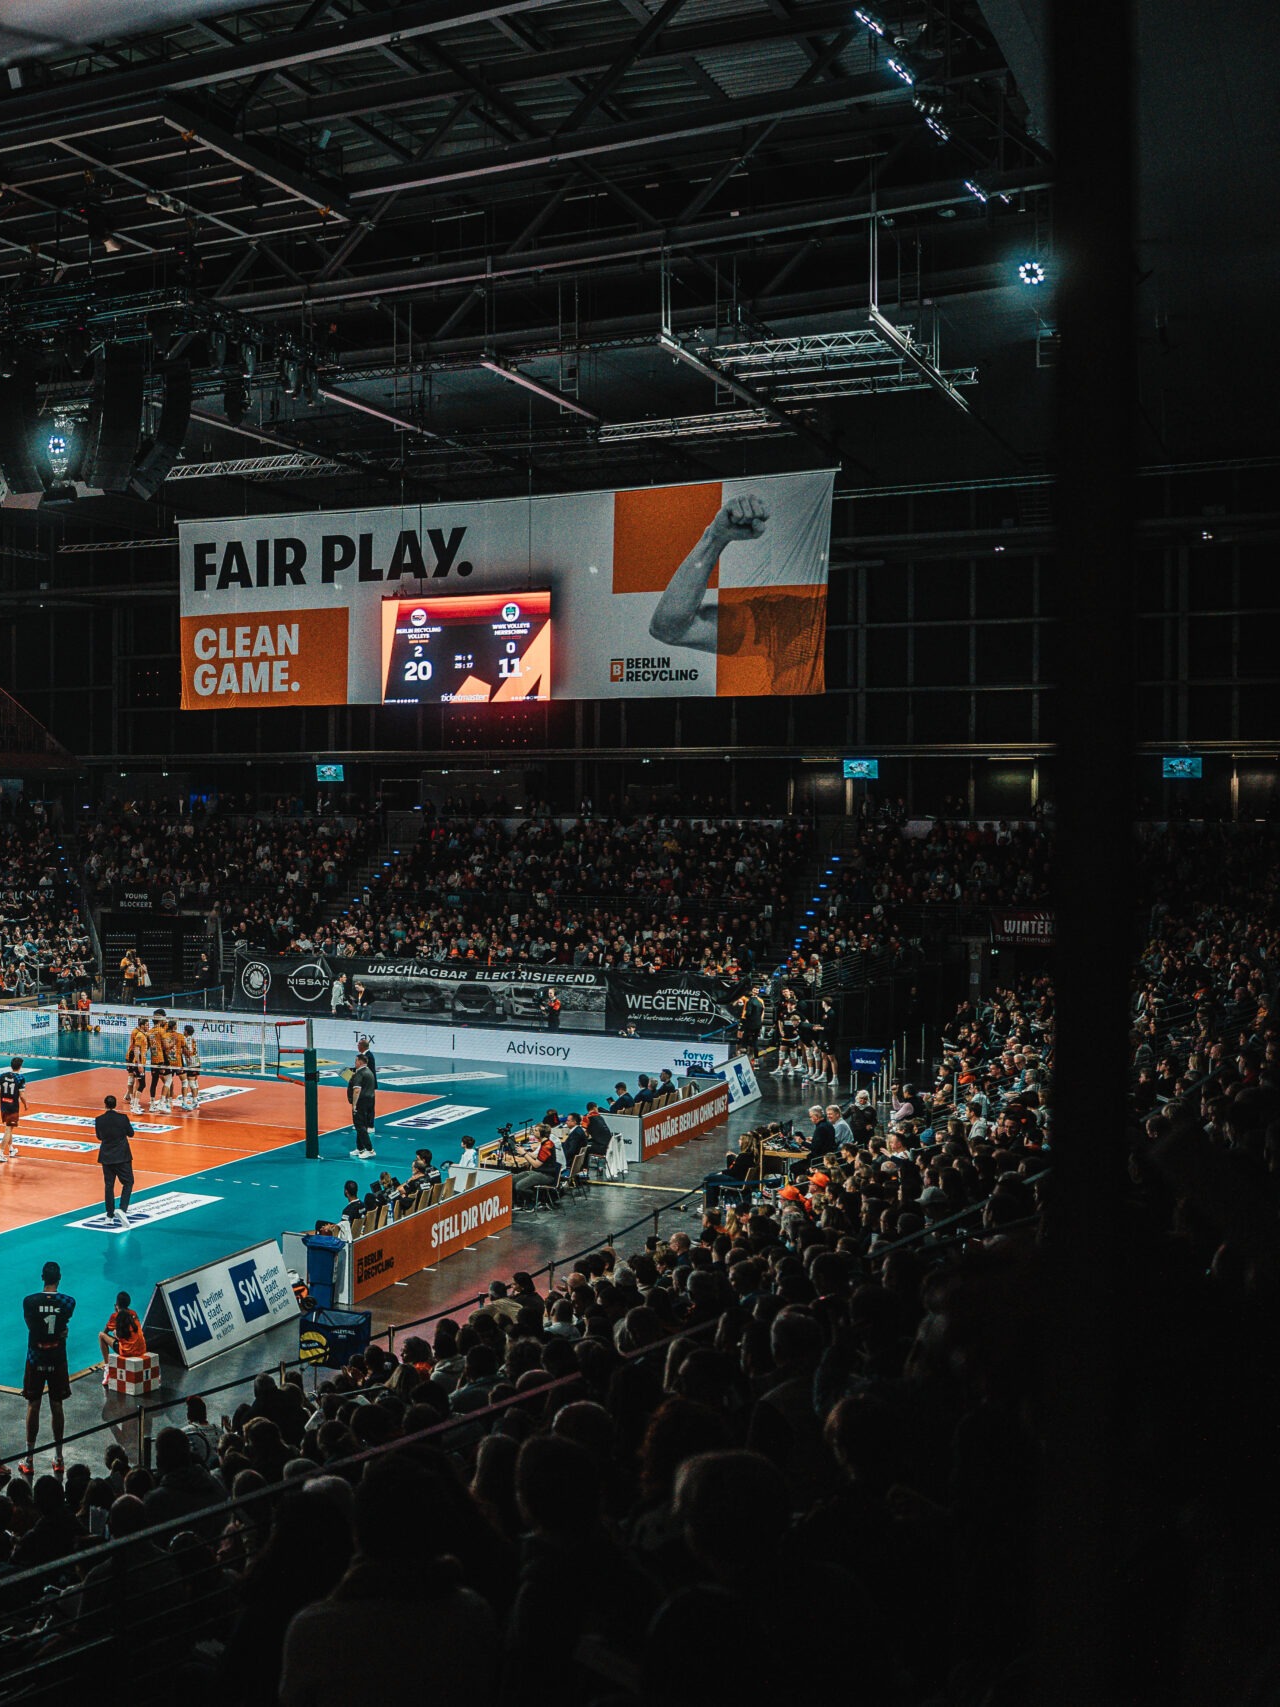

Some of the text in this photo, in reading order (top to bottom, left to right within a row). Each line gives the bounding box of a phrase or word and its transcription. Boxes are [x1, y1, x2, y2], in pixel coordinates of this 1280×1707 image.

[194, 526, 473, 592] FAIR PLAY.
[194, 624, 300, 659] CLEAN
[414, 645, 423, 657] 2
[506, 642, 516, 654] 0
[404, 661, 433, 681] 20
[498, 658, 523, 678] 11
[626, 657, 670, 671] BERLIN
[194, 659, 301, 697] GAME.
[626, 668, 699, 682] RECYCLING
[119, 900, 153, 908] BLOCKERZ
[125, 892, 148, 900] YOUNG
[1003, 919, 1054, 934] WINTER
[287, 977, 330, 986] NISSAN
[367, 964, 595, 984] UNSCHLAGBAR ELEKTRISIEREND
[655, 988, 701, 997] AUTOHAUS
[625, 994, 710, 1011] WEGENER
[98, 1018, 127, 1027] mazars
[201, 1020, 235, 1034] Audit
[643, 1013, 673, 1023] Vertrauen
[353, 1030, 375, 1045] Tax
[507, 1040, 570, 1060] Advisory
[683, 1049, 714, 1061] forvis
[673, 1058, 714, 1069] mazars
[2, 1081, 16, 1095] 11
[644, 1124, 661, 1148] WAS
[659, 1116, 679, 1141] WÄRE
[678, 1109, 700, 1134] BERLIN
[699, 1103, 714, 1126] OHNE
[431, 1195, 510, 1249] STELL DIR VOR...
[363, 1248, 383, 1269] BERLIN
[260, 1264, 280, 1286] berliner
[362, 1256, 395, 1282] RECYCLING
[238, 1277, 261, 1306] SM
[264, 1277, 279, 1296] stadt
[269, 1286, 288, 1306] mission
[203, 1287, 225, 1309] berliner
[179, 1300, 204, 1331] SM
[207, 1300, 223, 1319] stadt
[43, 1314, 57, 1335] 1
[211, 1311, 234, 1331] mission
